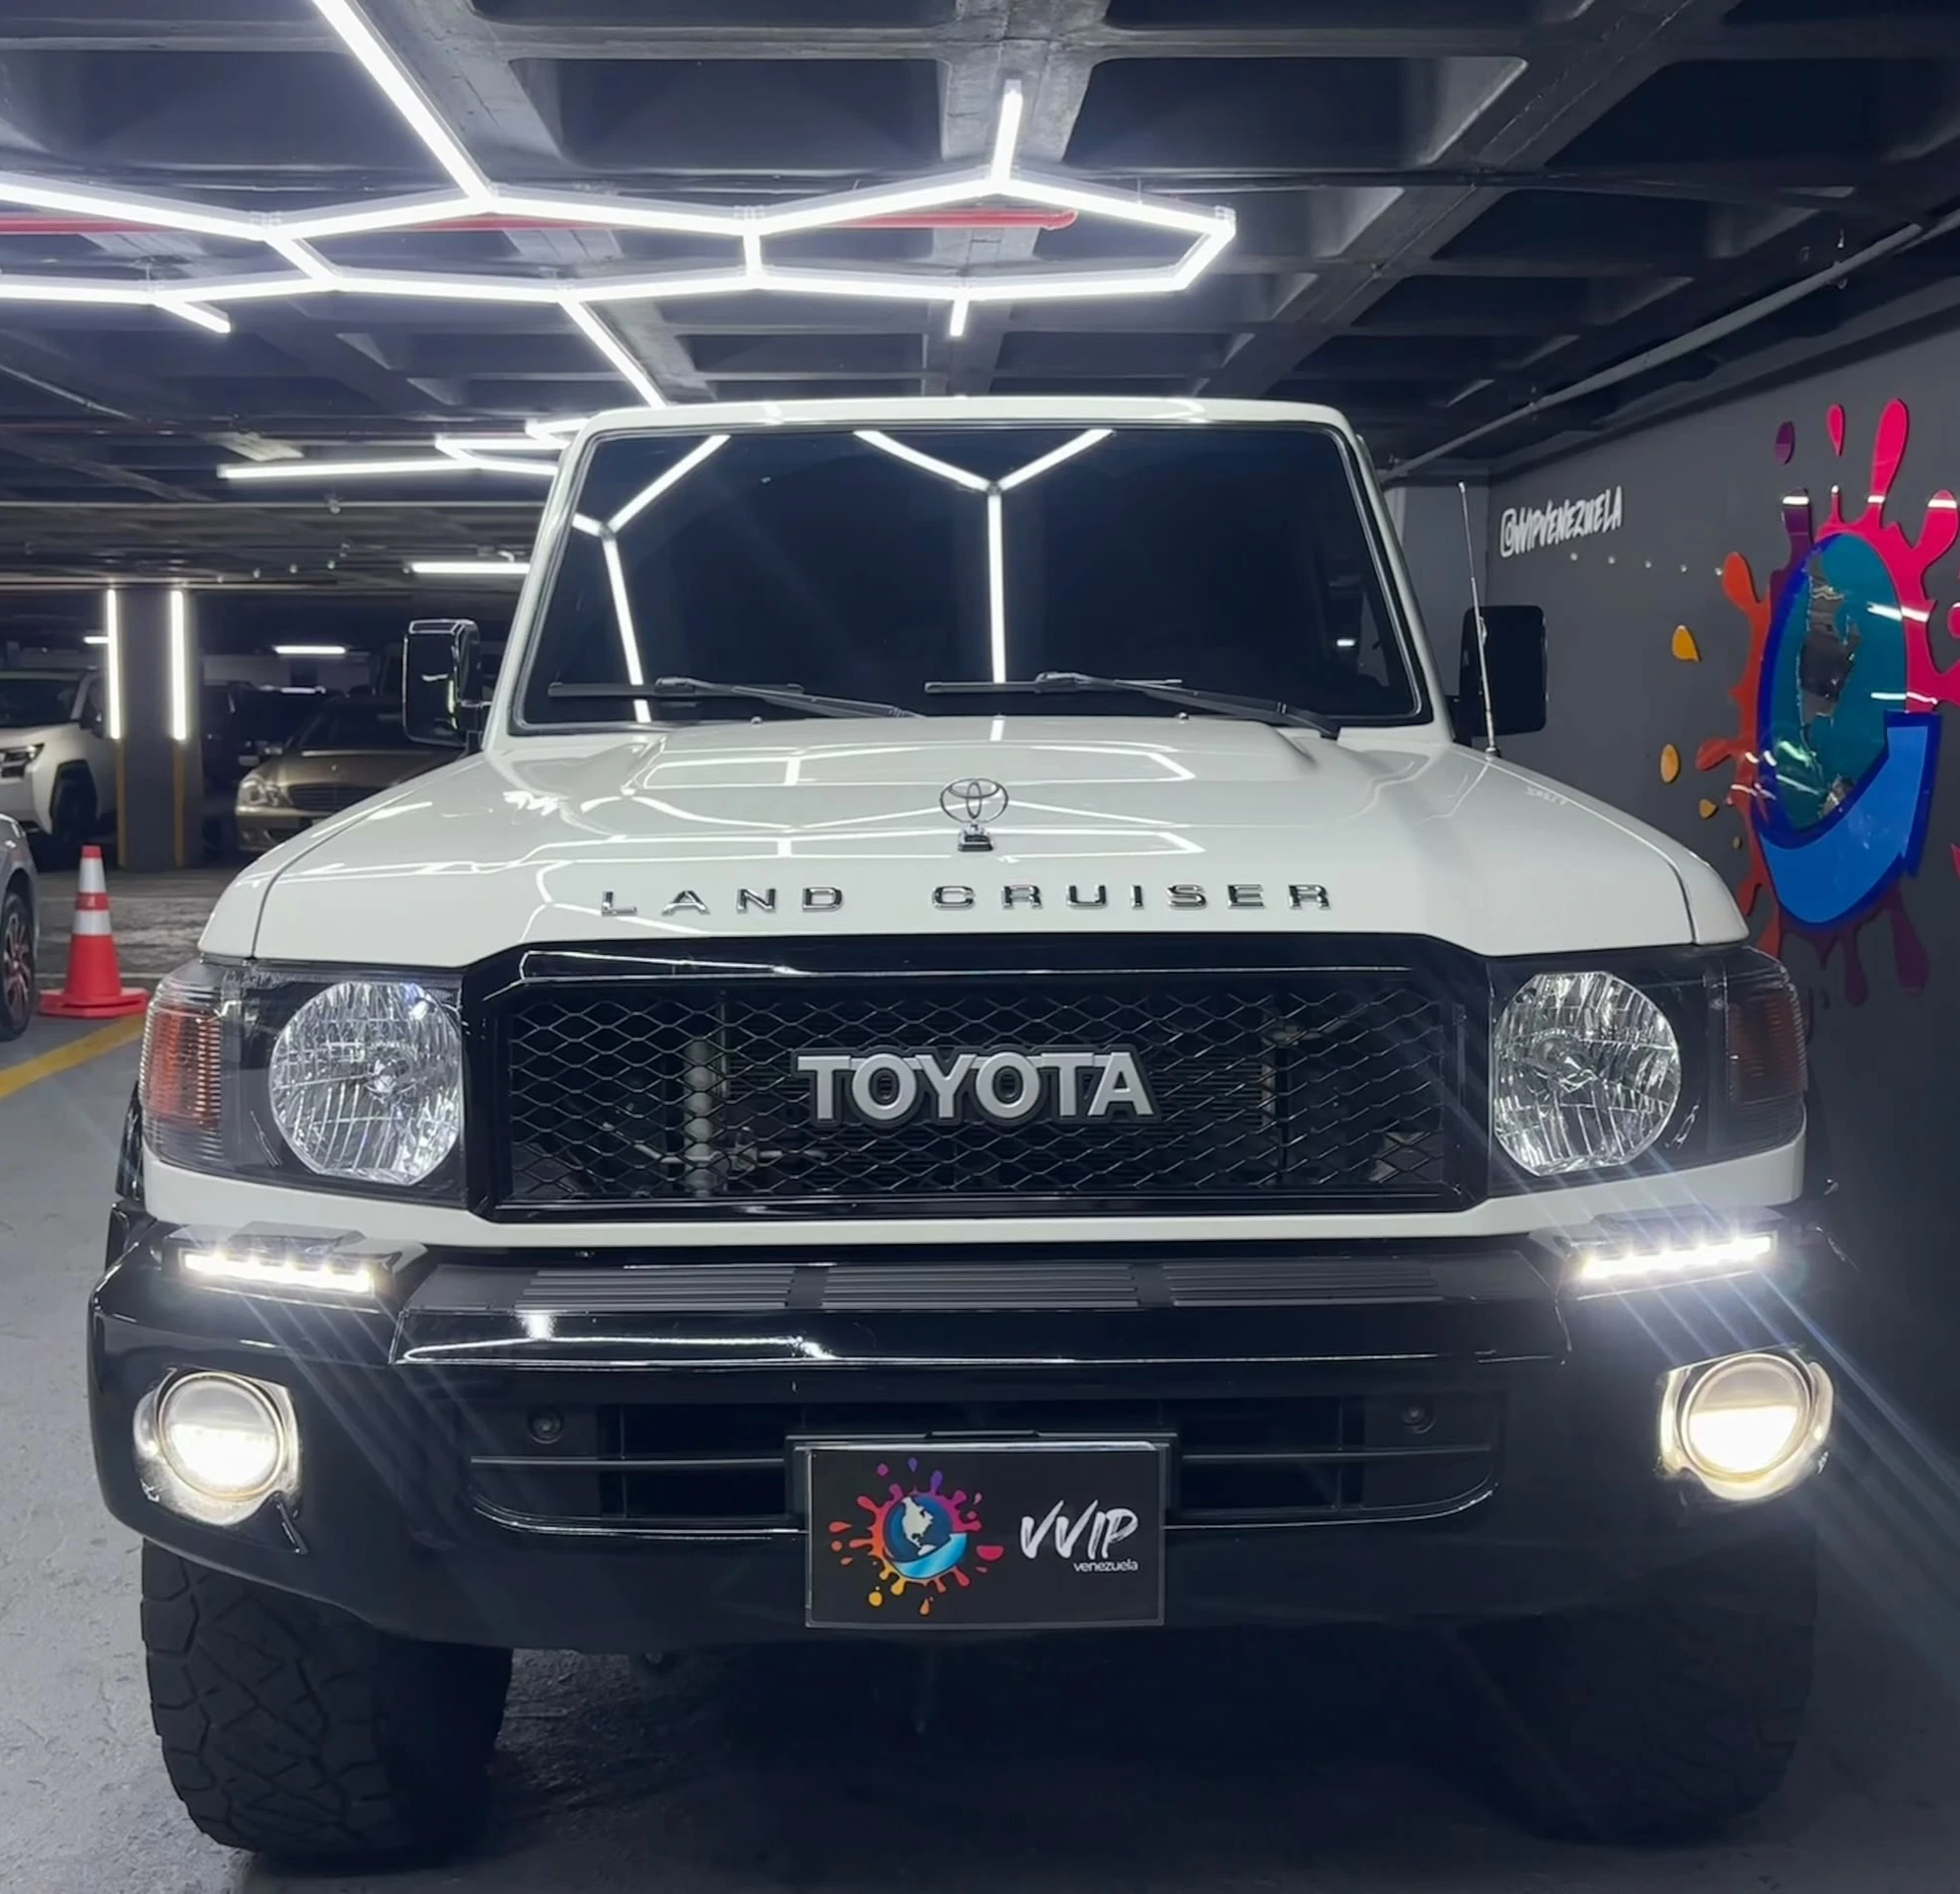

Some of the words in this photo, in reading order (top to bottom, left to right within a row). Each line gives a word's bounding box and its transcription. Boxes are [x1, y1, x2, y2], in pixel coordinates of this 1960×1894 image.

[601, 886, 843, 915] LAND
[931, 884, 1333, 910] CRUISER
[796, 1051, 1155, 1121] TOYOTA
[1020, 1499, 1139, 1560] VVIP
[1073, 1559, 1139, 1572] venezuela
